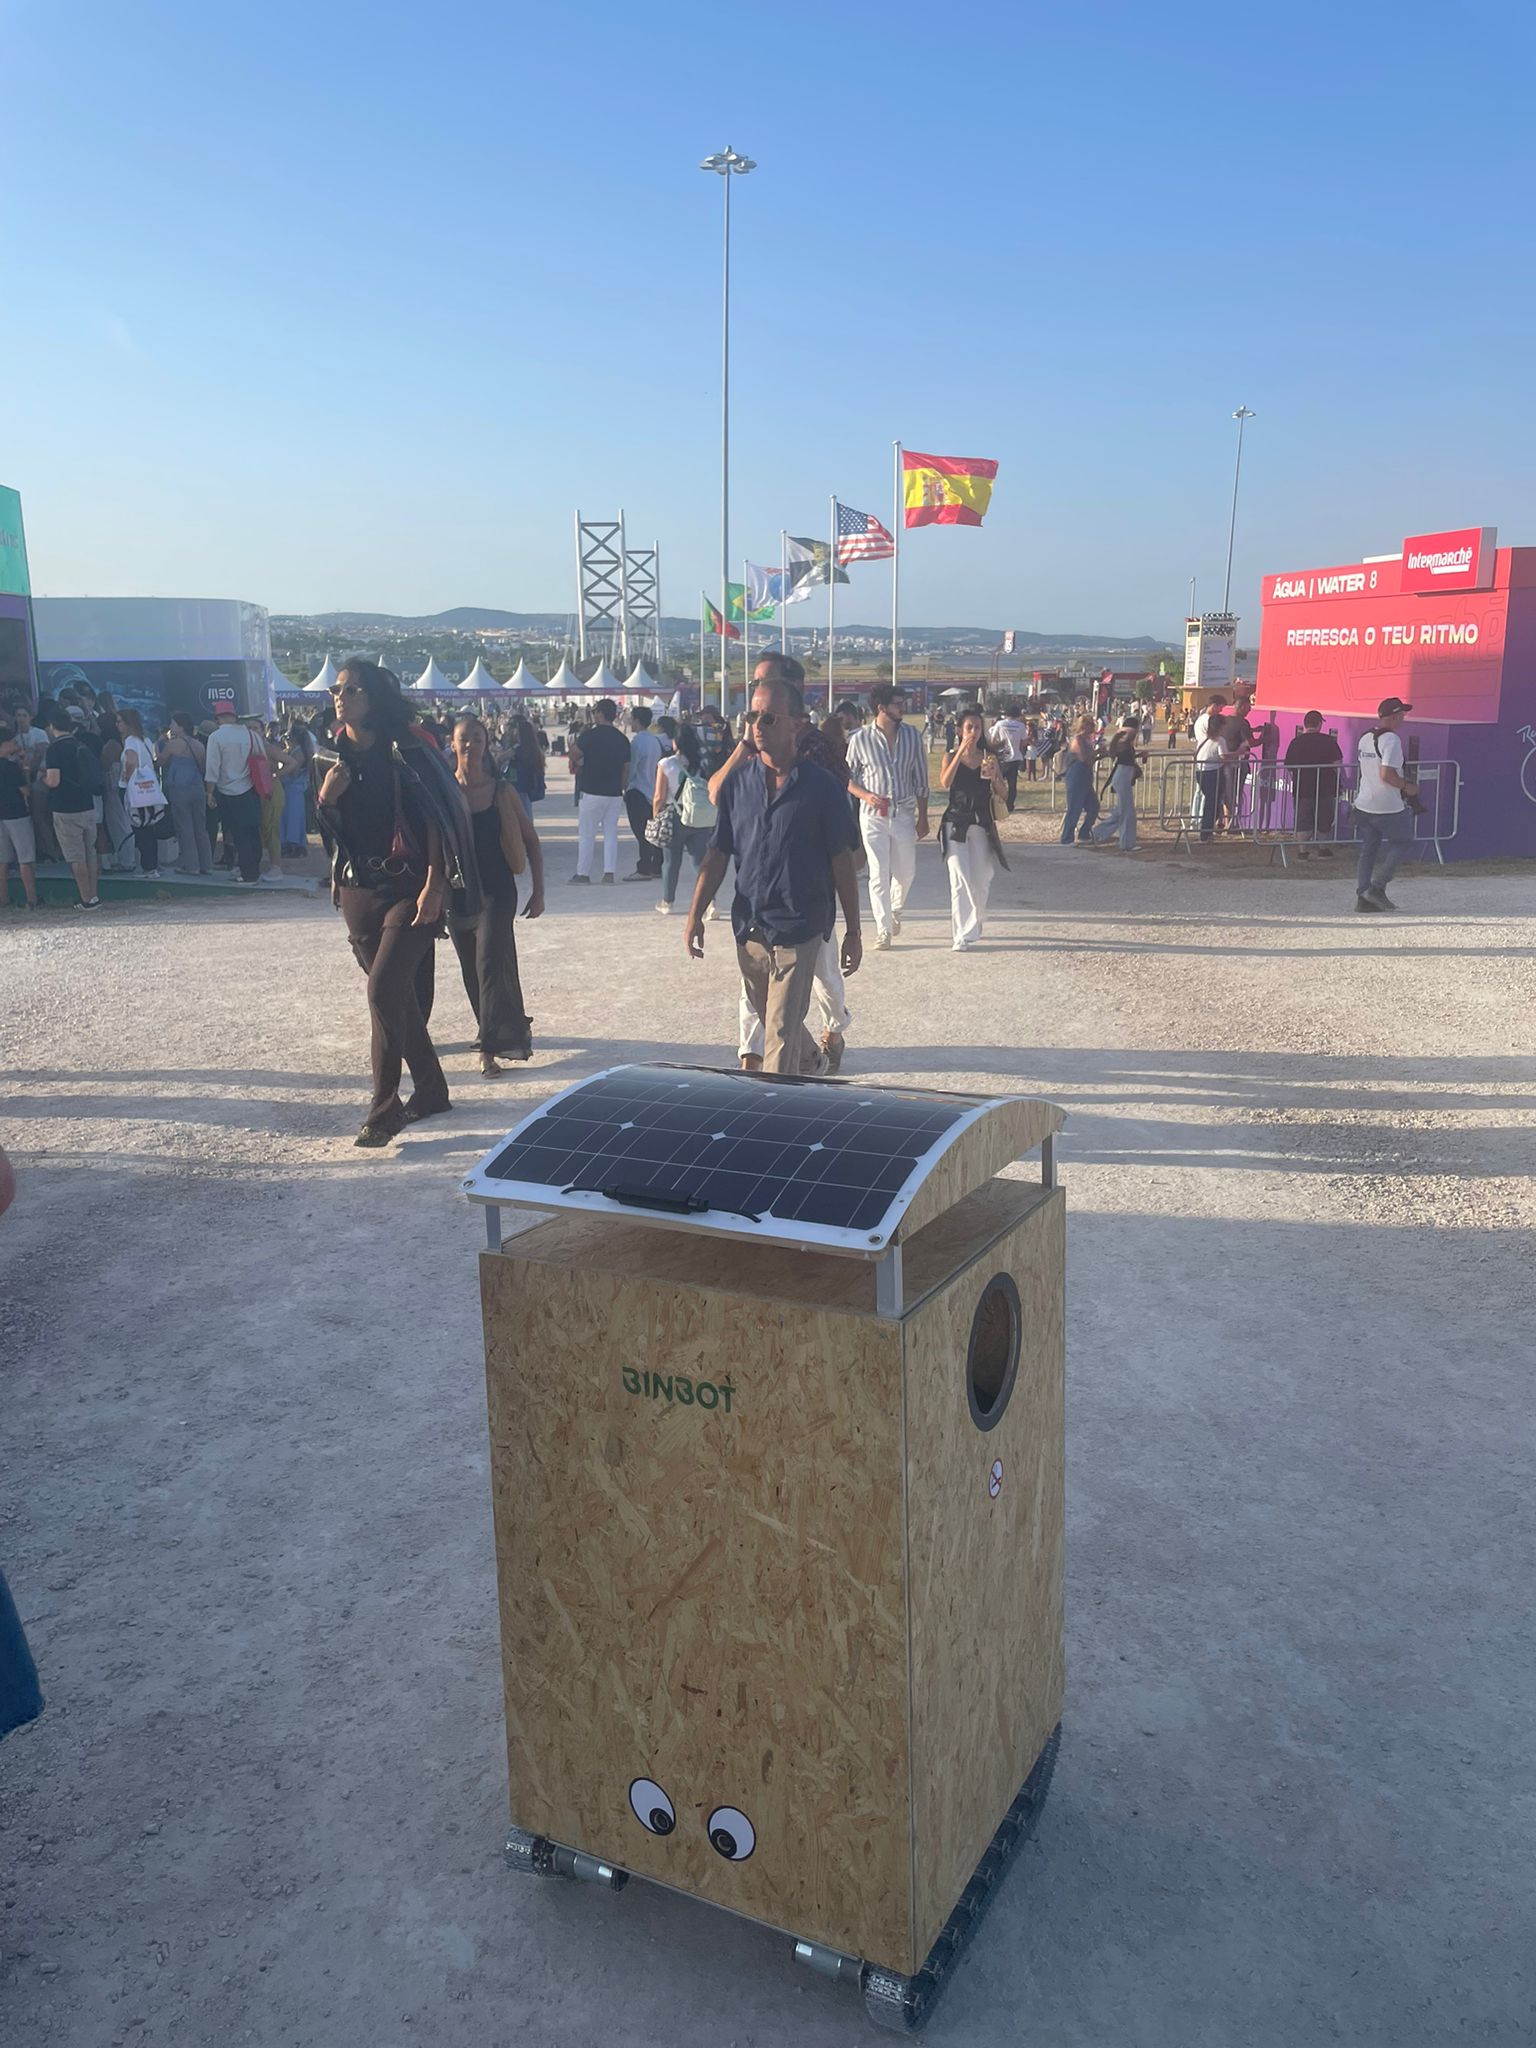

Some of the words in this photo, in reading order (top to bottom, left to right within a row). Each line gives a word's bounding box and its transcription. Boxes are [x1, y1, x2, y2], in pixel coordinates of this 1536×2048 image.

[1407, 547, 1473, 572] Intermarché
[1273, 577, 1306, 599] ÁGUA
[1317, 573, 1366, 595] WATER
[1286, 628, 1359, 646] REFRESCA
[1364, 628, 1376, 645] O
[1382, 626, 1415, 645] TEU
[1419, 623, 1480, 645] RITMO
[208, 687, 235, 699] MEO
[622, 1366, 737, 1413] BINBOT
